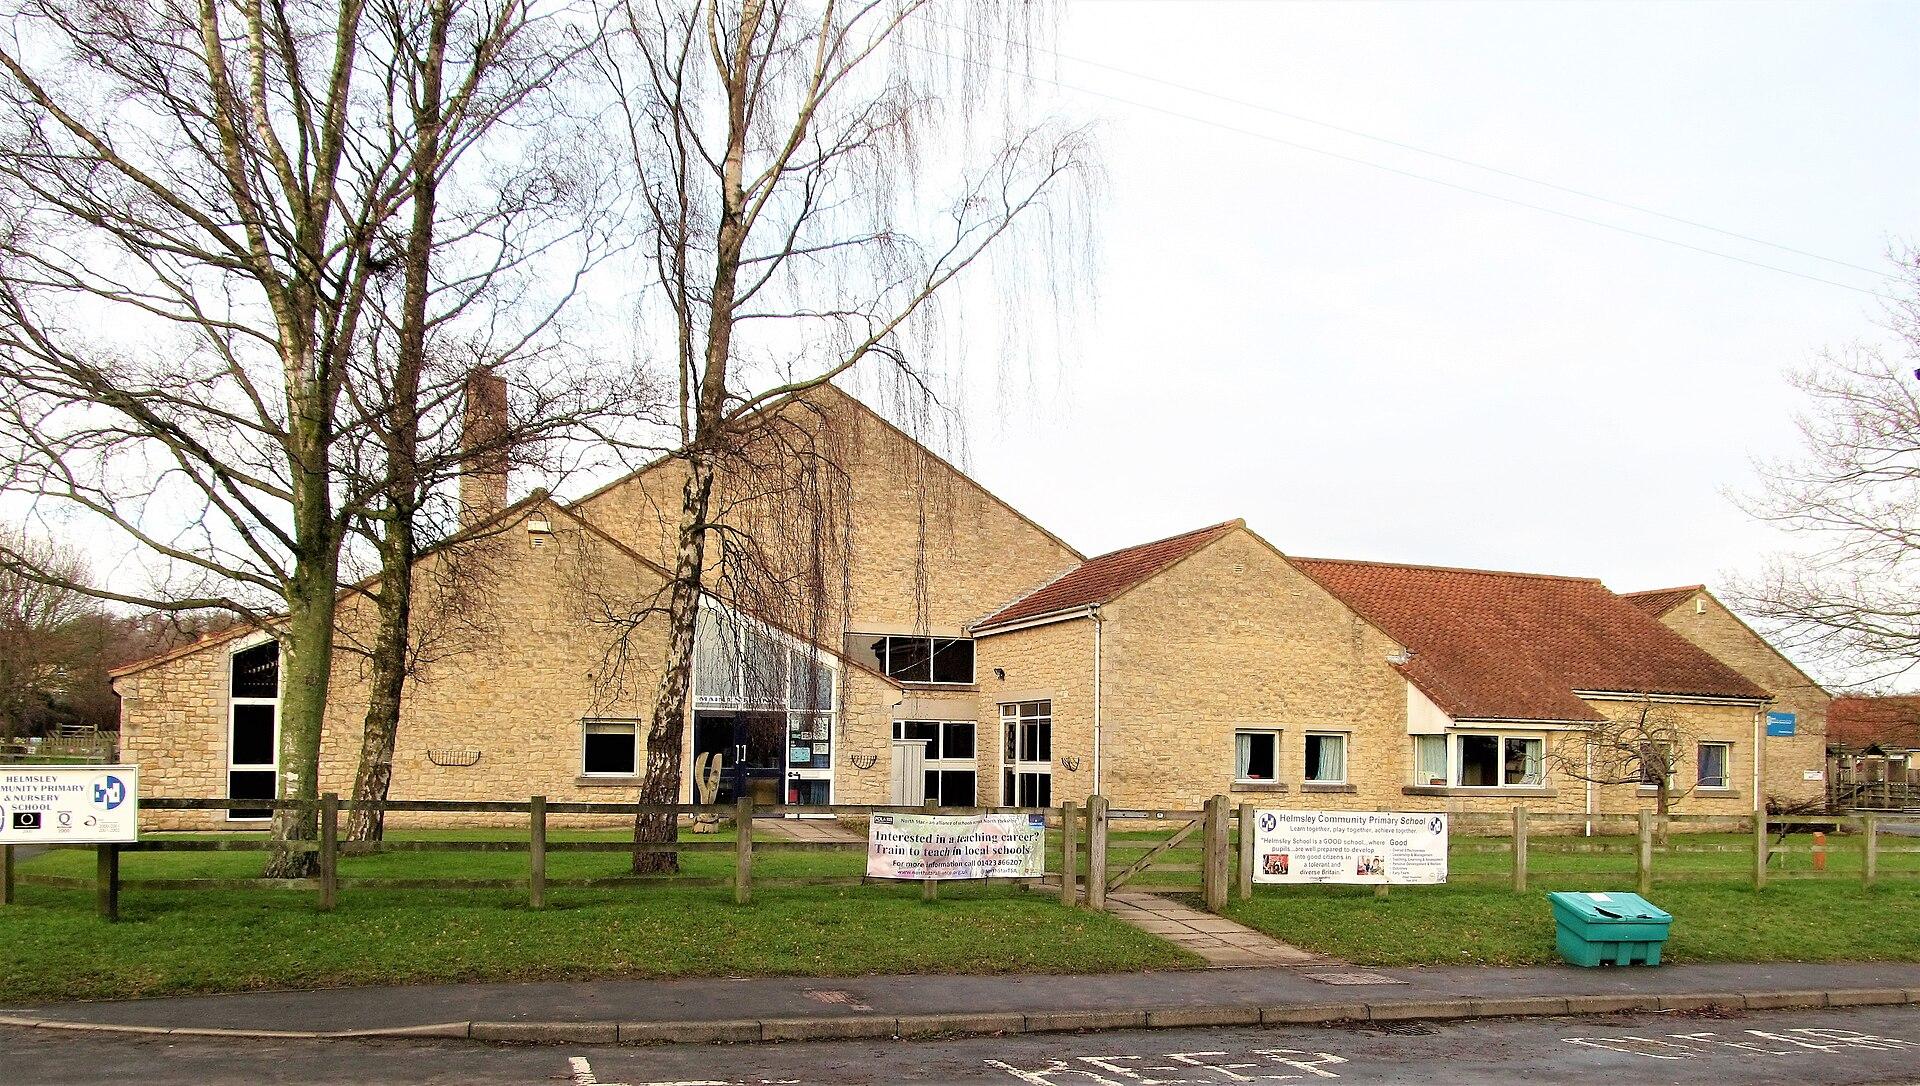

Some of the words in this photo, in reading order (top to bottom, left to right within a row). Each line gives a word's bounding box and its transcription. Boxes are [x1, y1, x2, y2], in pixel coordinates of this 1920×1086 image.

[1280, 814, 1316, 824] Helmsley
[1318, 815, 1366, 825] Community
[1369, 816, 1398, 826] Primary
[1400, 817, 1426, 825] School
[876, 830, 932, 844] Interested
[936, 834, 946, 844] in
[957, 832, 998, 844] teaching
[1001, 832, 1039, 842] career?
[875, 844, 905, 855] Train
[910, 847, 920, 856] to
[924, 847, 950, 856] teach
[953, 846, 961, 856] in
[966, 845, 988, 854] local
[992, 844, 1030, 854] schools
